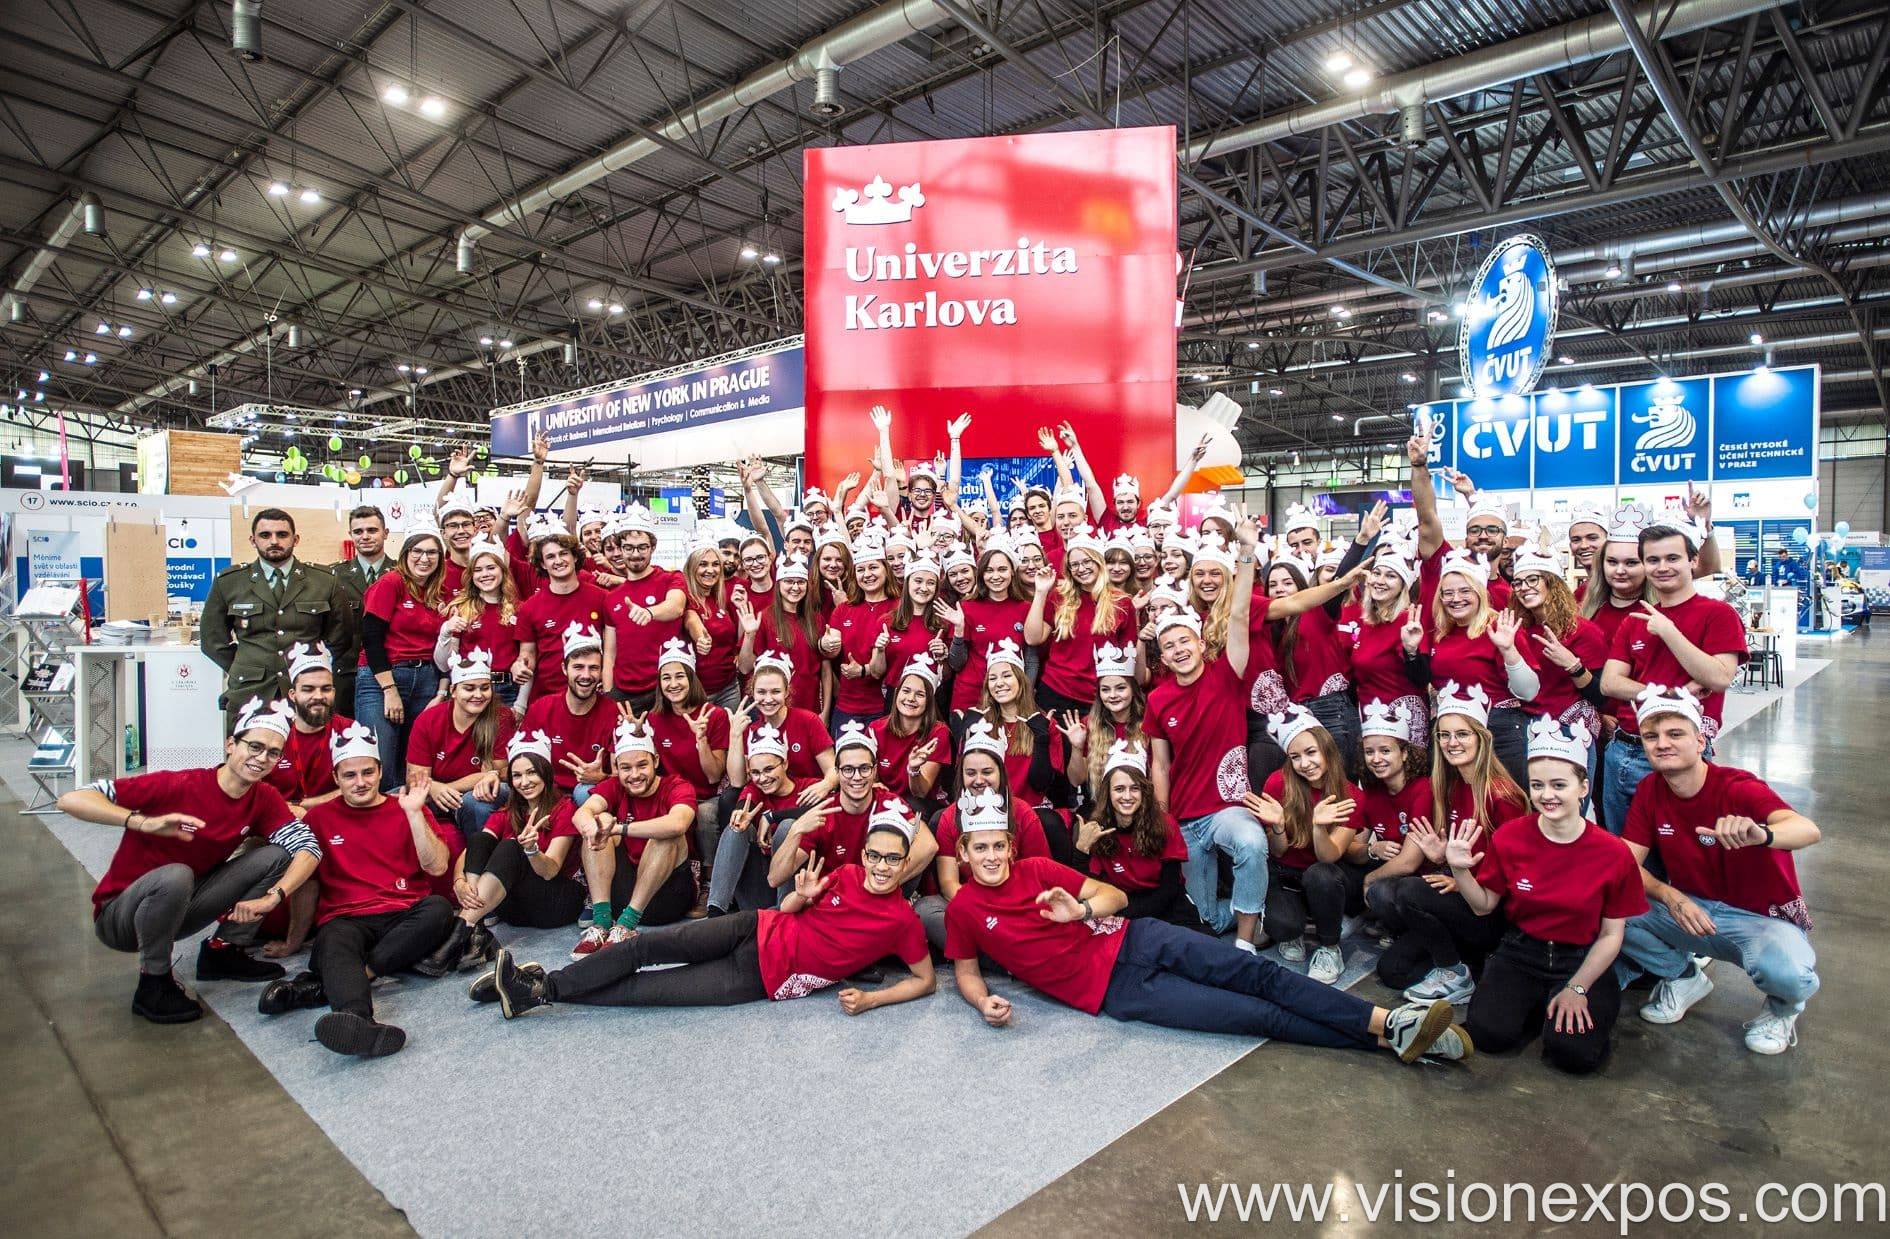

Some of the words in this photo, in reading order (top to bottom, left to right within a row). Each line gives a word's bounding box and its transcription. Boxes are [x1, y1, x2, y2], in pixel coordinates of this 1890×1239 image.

[845, 237, 1079, 282] Univerzita
[845, 291, 1017, 330] Karlova
[1481, 346, 1533, 385] ČVUT
[546, 403, 603, 430] UNIVERSITY
[606, 399, 621, 419] OF
[623, 392, 651, 416] NEW
[654, 384, 690, 410] YORK
[692, 380, 707, 401] IN
[710, 365, 770, 401] PRAGUE
[652, 411, 684, 426] Psychology
[689, 401, 739, 419] Communication
[748, 393, 770, 407] Media
[1462, 410, 1608, 459] ČVUT
[1719, 442, 1748, 451] ČESKÉ
[1750, 439, 1789, 450] VYSOKÉ
[1719, 450, 1748, 460] UČENÍ
[1750, 447, 1804, 459] TECHNICKÉ
[1630, 452, 1696, 473] ČVUT
[1727, 460, 1757, 469] PRAZE
[27, 497, 38, 505] 17
[168, 538, 197, 549] CIO
[166, 563, 195, 571] árodní
[166, 571, 205, 580] ovnávací
[167, 582, 194, 590] oušky
